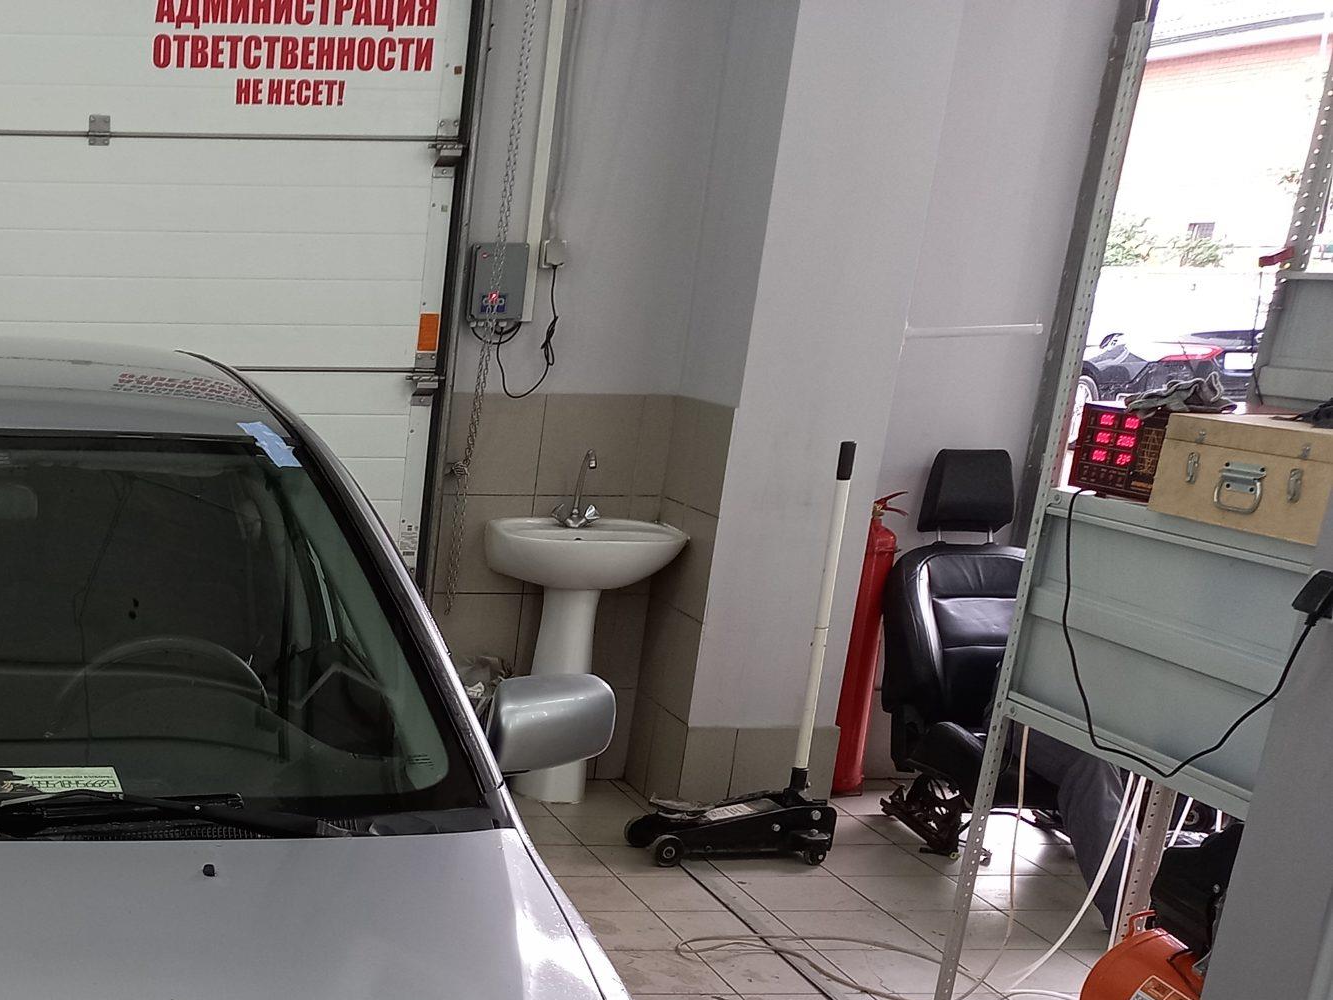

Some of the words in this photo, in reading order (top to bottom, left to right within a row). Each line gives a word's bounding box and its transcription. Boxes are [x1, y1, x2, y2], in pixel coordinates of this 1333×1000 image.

[155, 0, 437, 32] АДМИНИСТРАЦИЯ
[152, 34, 435, 72] ОТВЕТСТВЕННОСТИ
[235, 78, 263, 105] НЕ
[267, 79, 346, 106] НЕСЕТ!
